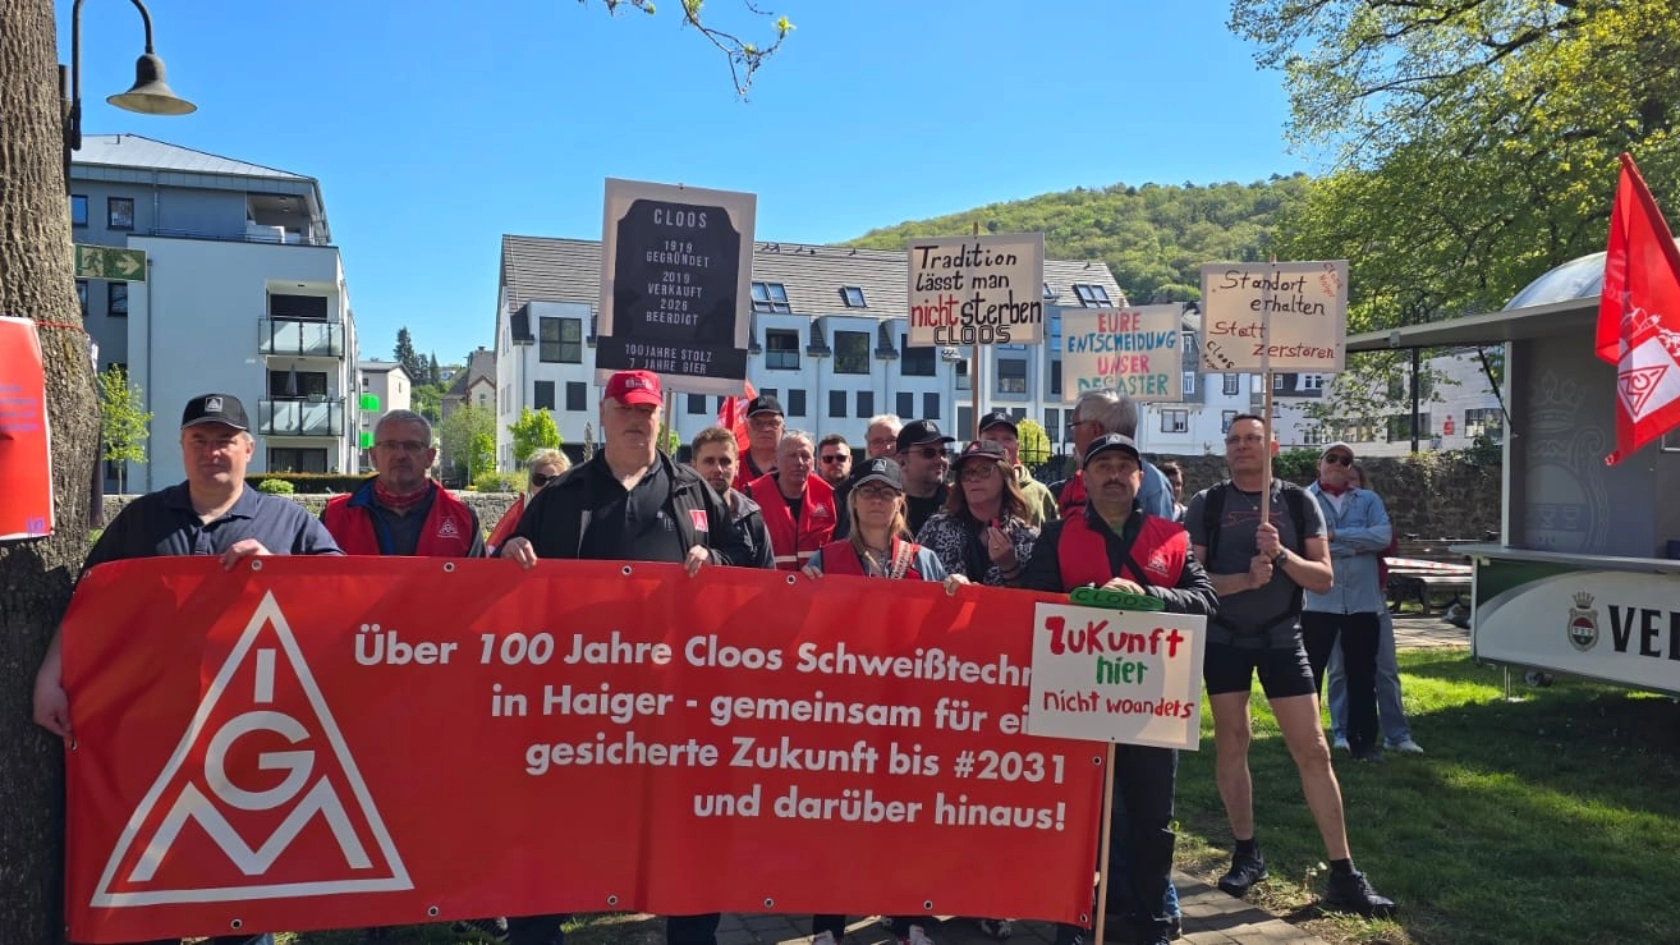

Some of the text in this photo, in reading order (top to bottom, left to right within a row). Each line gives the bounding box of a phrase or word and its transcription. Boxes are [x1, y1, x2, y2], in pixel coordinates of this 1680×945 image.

[654, 208, 707, 229] CLOOS
[665, 241, 693, 254] 1919
[914, 243, 1017, 270] Tradition
[646, 252, 709, 268] GEGRÜNDET
[662, 271, 690, 284] 2019
[972, 275, 1009, 289] man
[1219, 270, 1309, 294] Standort
[647, 284, 703, 298] VERKAUFT
[911, 290, 1042, 328] nicht sterben
[1250, 295, 1326, 316] erhalten
[646, 311, 699, 325] BEERDIGT
[1098, 311, 1141, 333] EURE
[933, 325, 1011, 345] CLOOS
[1209, 321, 1266, 339] Statt
[1068, 330, 1177, 353] ENTSCHEIDUNG
[629, 357, 707, 374] 7 JAHRE GIER
[681, 348, 712, 362] STOLZ
[1097, 355, 1150, 375] UNSER
[355, 624, 457, 665] Über
[480, 632, 554, 665] 100
[564, 631, 672, 665] Jahre
[685, 635, 783, 670] Cloos
[1096, 655, 1148, 684] hier
[492, 683, 527, 716] in
[543, 682, 674, 724] Haiger
[710, 691, 921, 727] gemeinsam
[934, 697, 987, 733] für
[1043, 690, 1194, 718] nicht woanders
[525, 730, 1065, 784] gesicherte Zukunft bis #2031
[694, 784, 1066, 831] und darüber hinaus!
